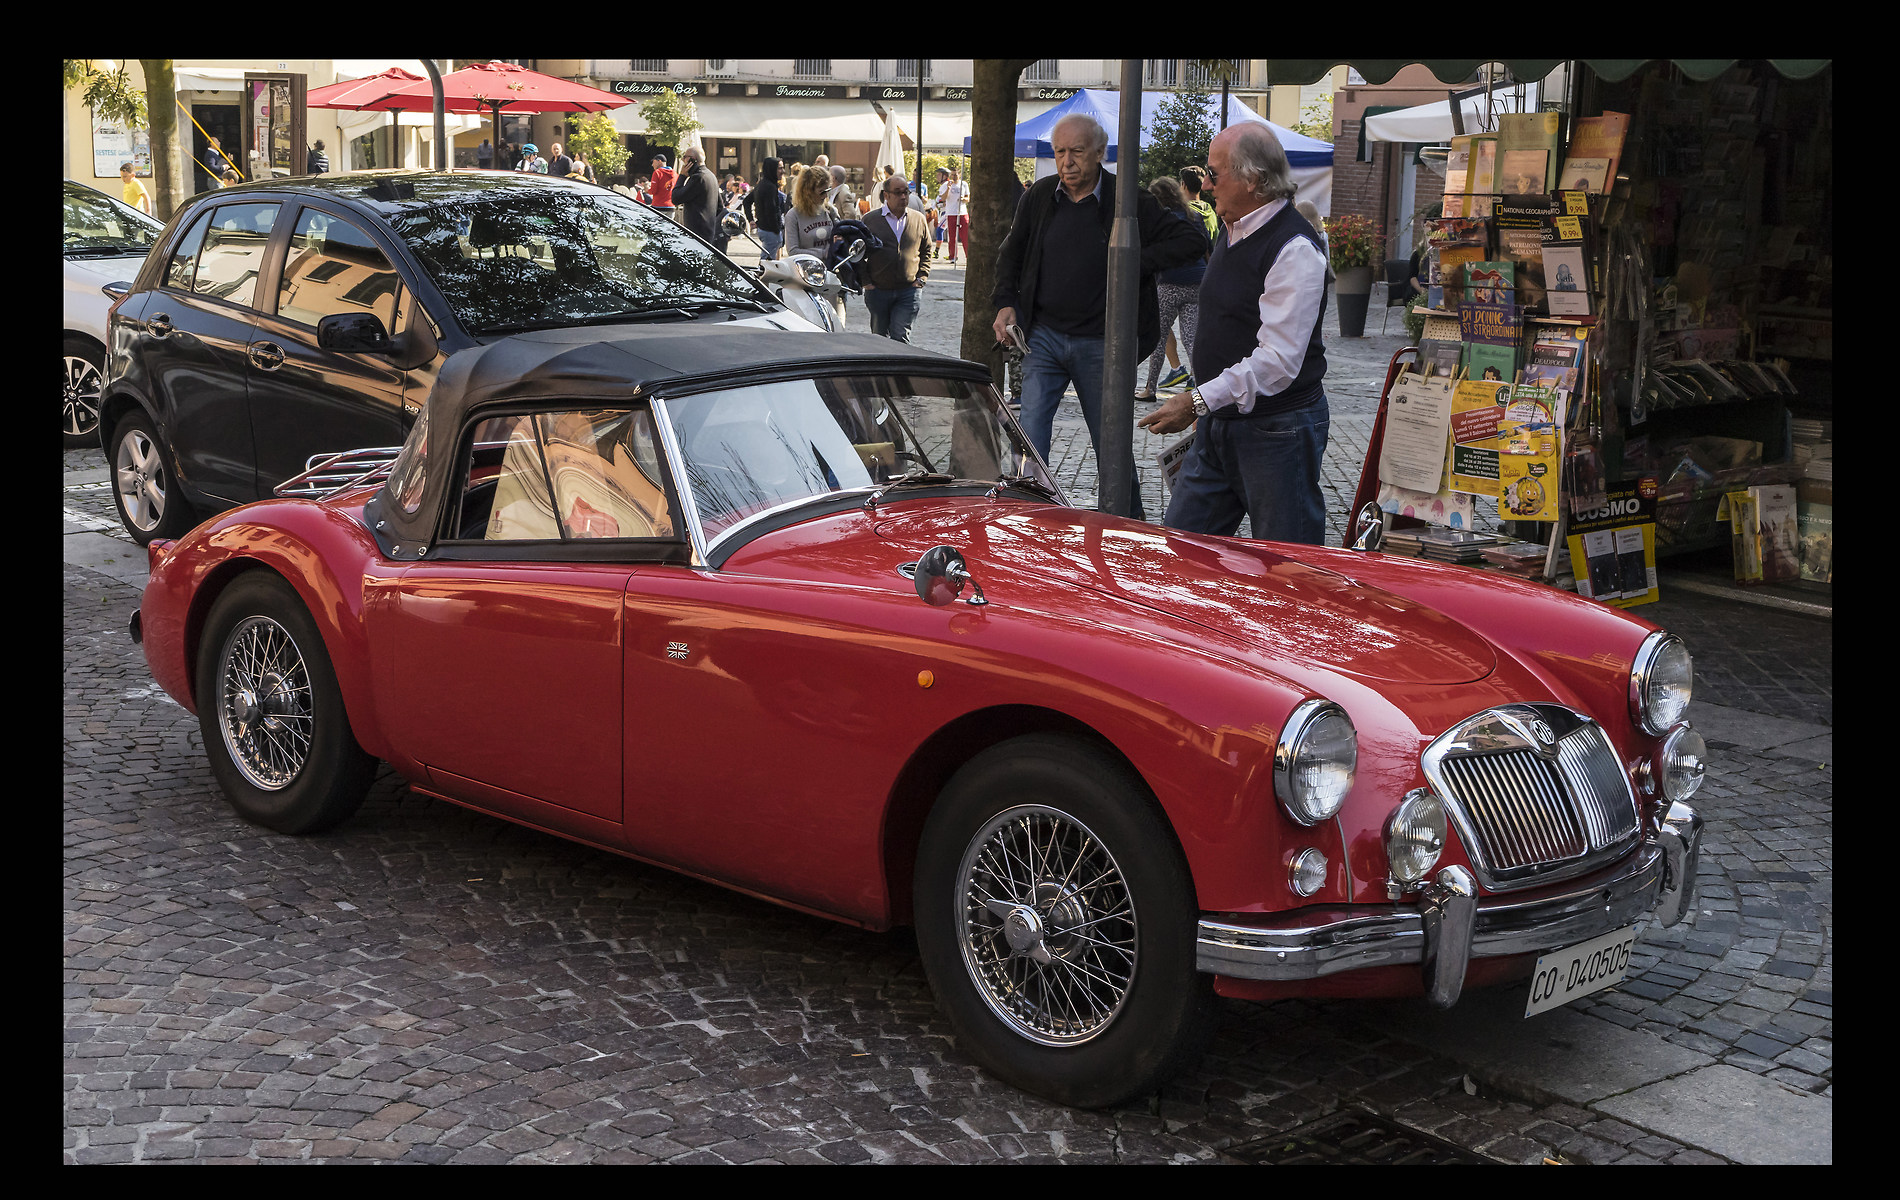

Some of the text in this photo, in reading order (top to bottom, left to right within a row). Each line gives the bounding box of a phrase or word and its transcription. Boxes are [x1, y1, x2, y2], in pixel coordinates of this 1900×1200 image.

[615, 81, 698, 96] Gelateria Bar
[775, 85, 826, 97] Francioni
[882, 87, 906, 99] Bar
[1038, 88, 1080, 99] Gelater
[1503, 207, 1525, 215] NATIONAL
[1474, 310, 1506, 325] DONNE
[1534, 357, 1566, 366] DEADPOOL
[1532, 939, 1633, 1004] CO D40505
